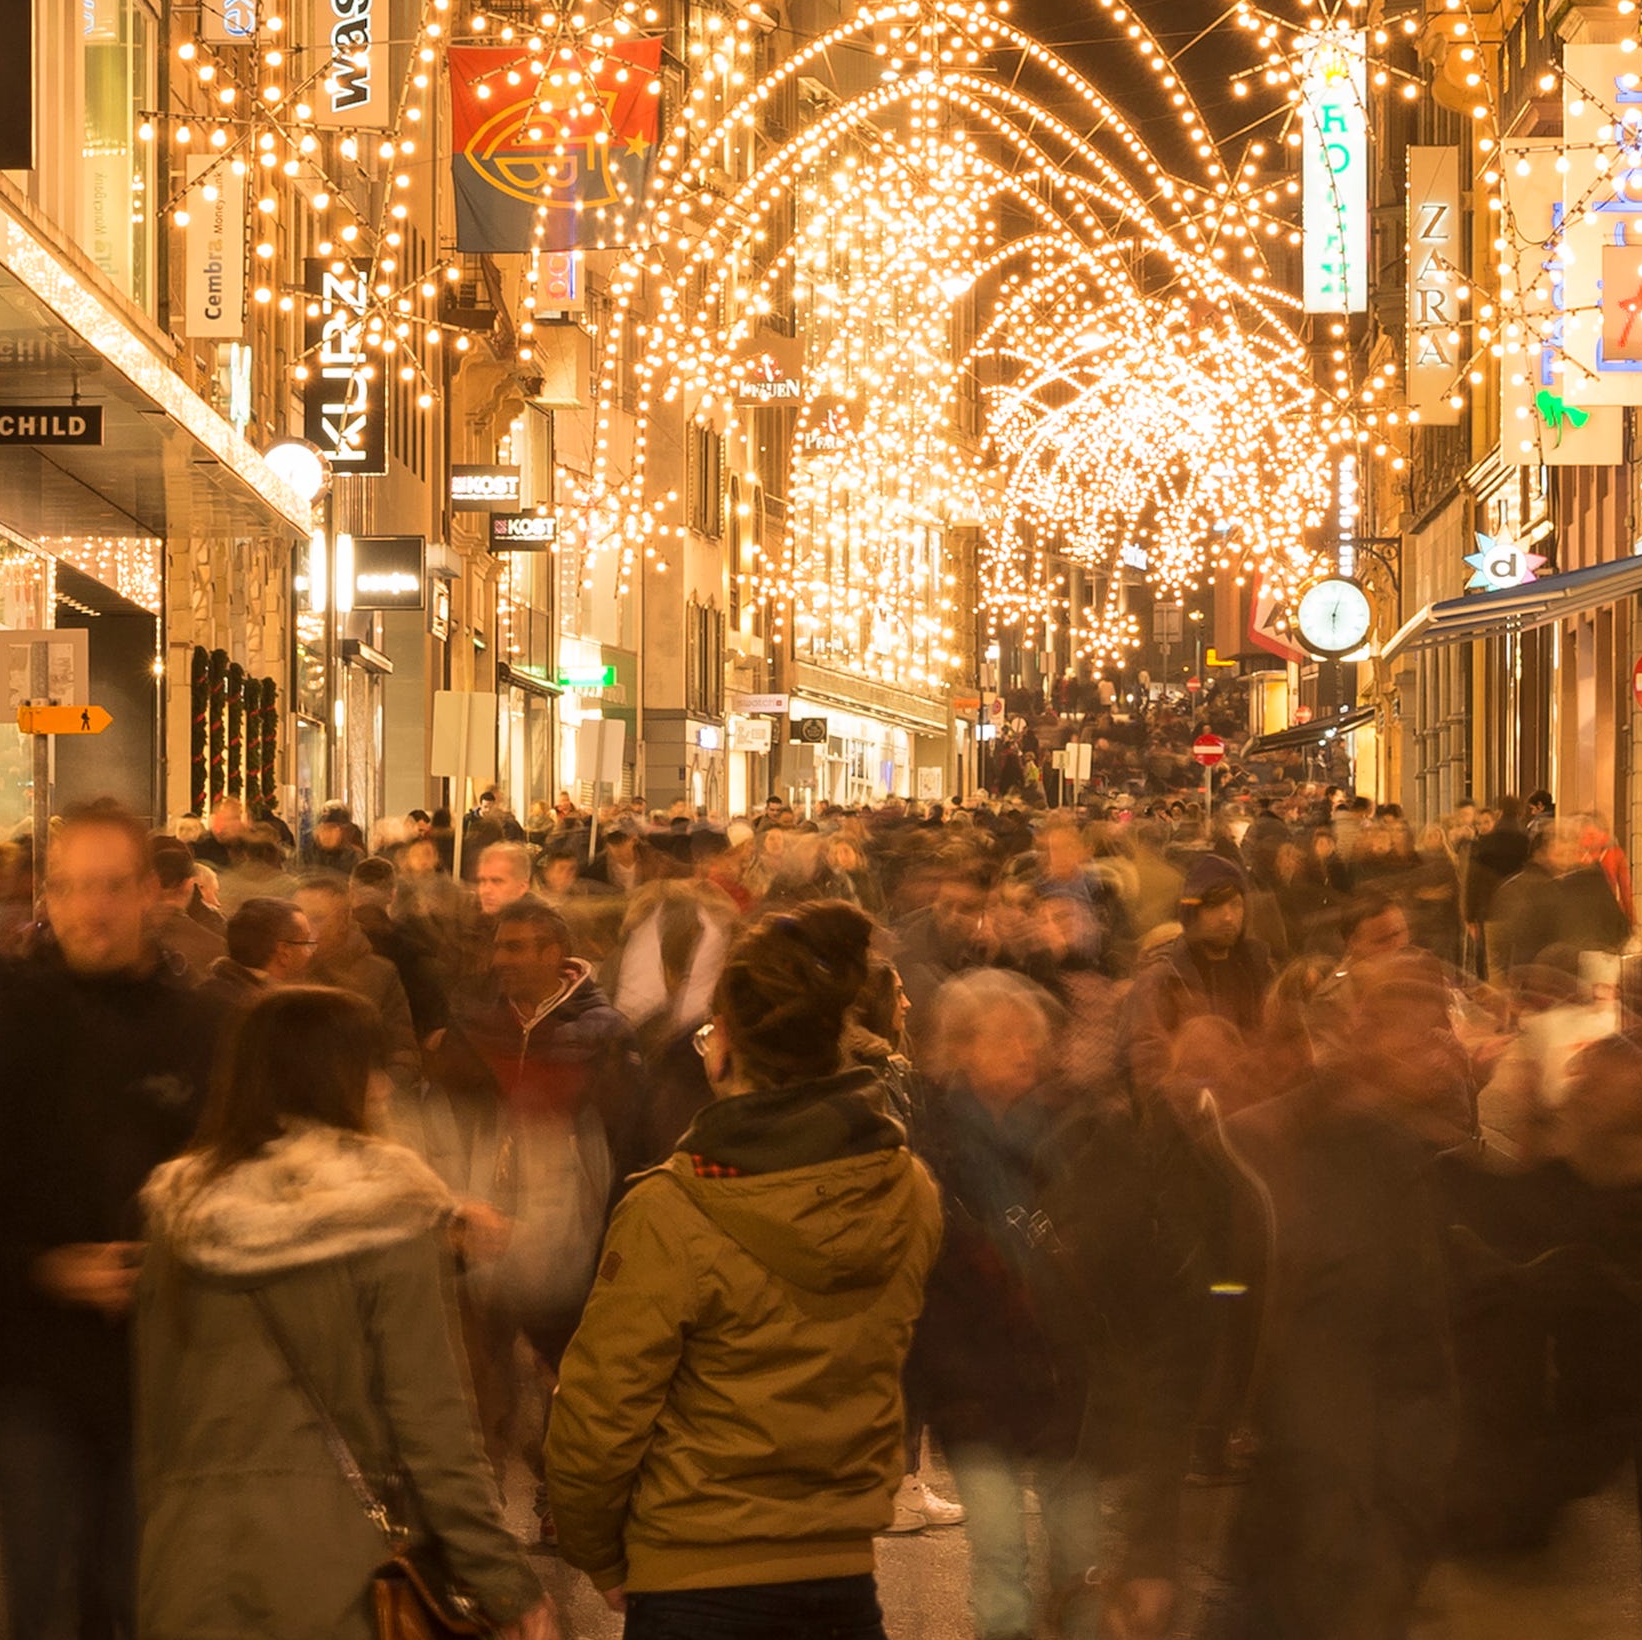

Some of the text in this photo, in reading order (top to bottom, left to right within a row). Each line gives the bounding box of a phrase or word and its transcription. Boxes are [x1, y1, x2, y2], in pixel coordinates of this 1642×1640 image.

[203, 239, 224, 321] Cembra
[1416, 205, 1453, 367] ZARA
[321, 271, 367, 461] KURZ
[467, 476, 520, 495] KOST
[508, 518, 557, 536] KOST
